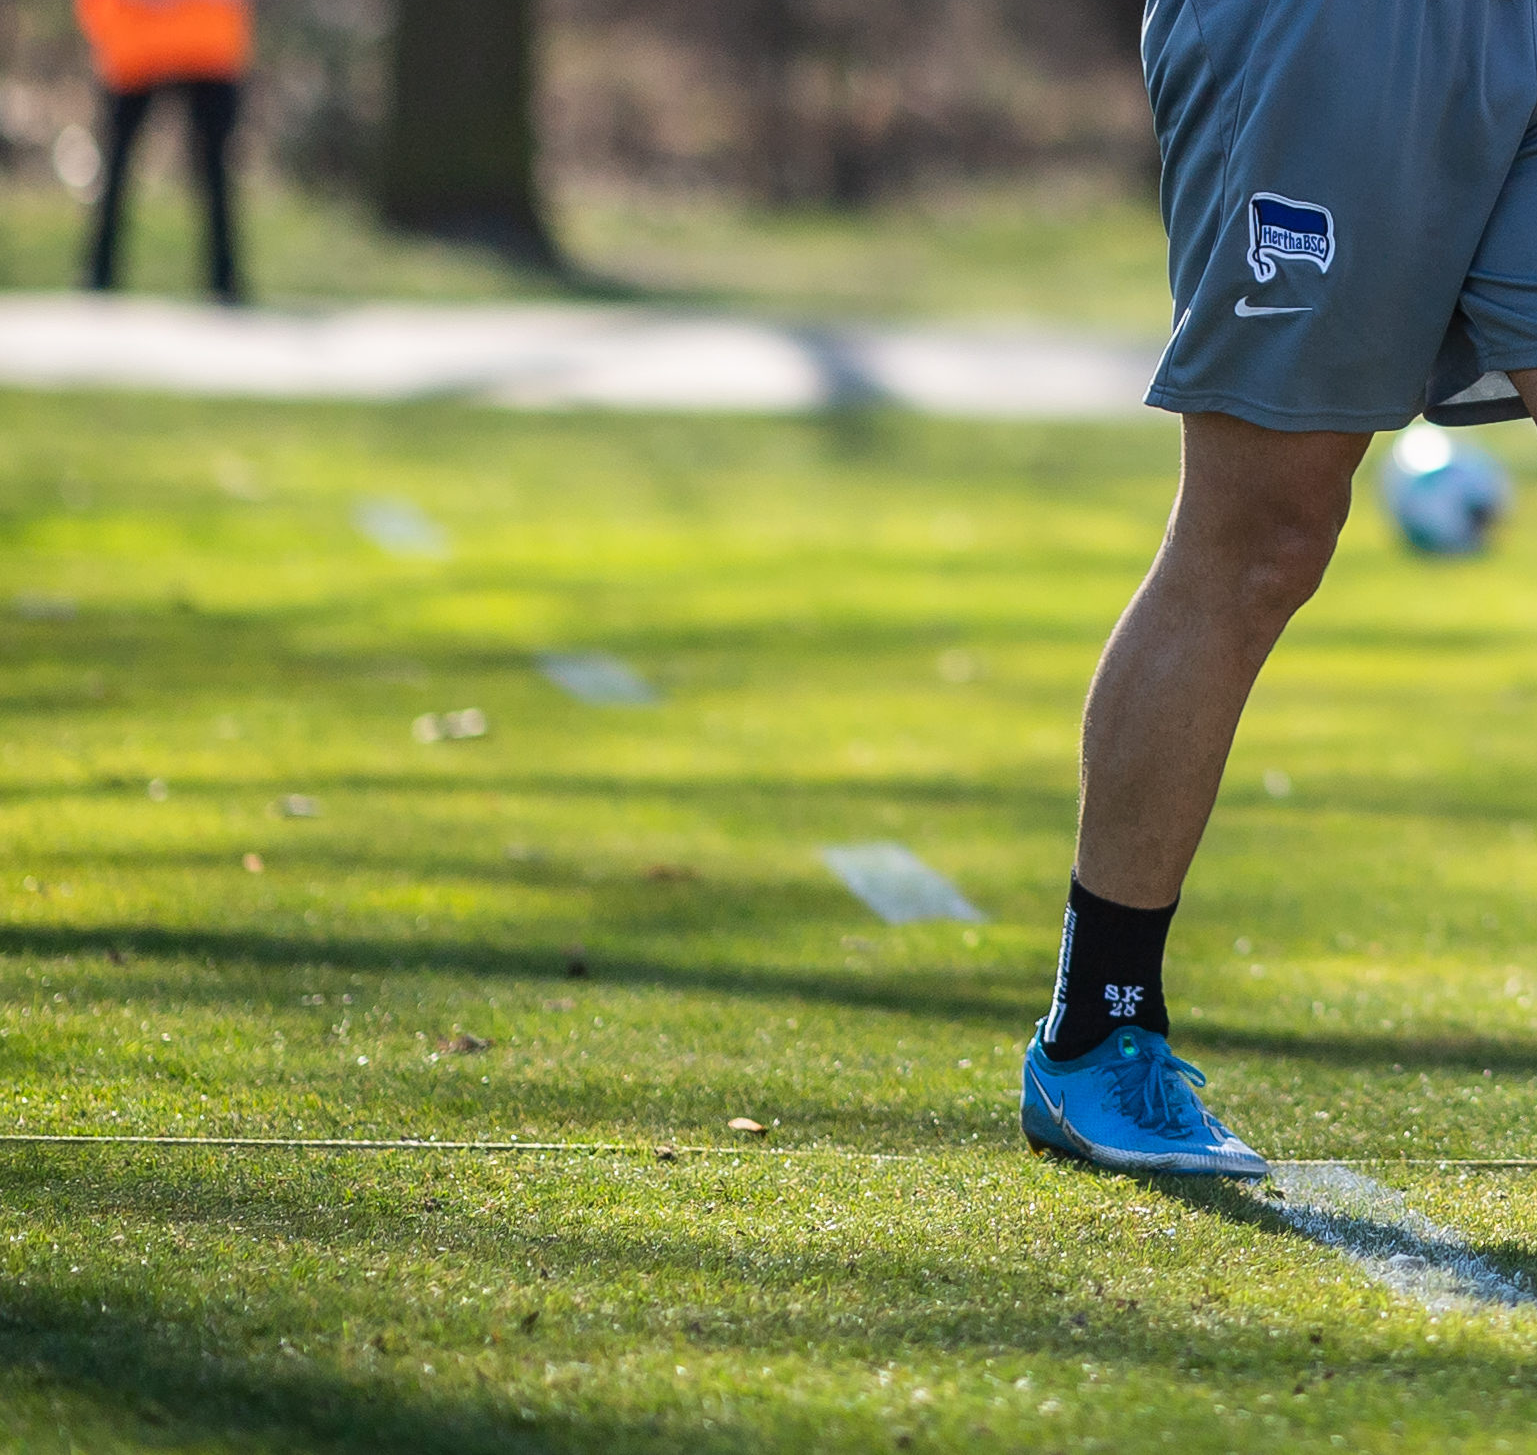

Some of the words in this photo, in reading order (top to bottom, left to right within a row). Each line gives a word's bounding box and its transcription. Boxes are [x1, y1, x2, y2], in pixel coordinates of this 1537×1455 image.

[1264, 227, 1302, 249] Hertha
[1303, 235, 1325, 255] BSC
[1104, 984, 1144, 1003] SK
[1109, 1002, 1136, 1017] 28
